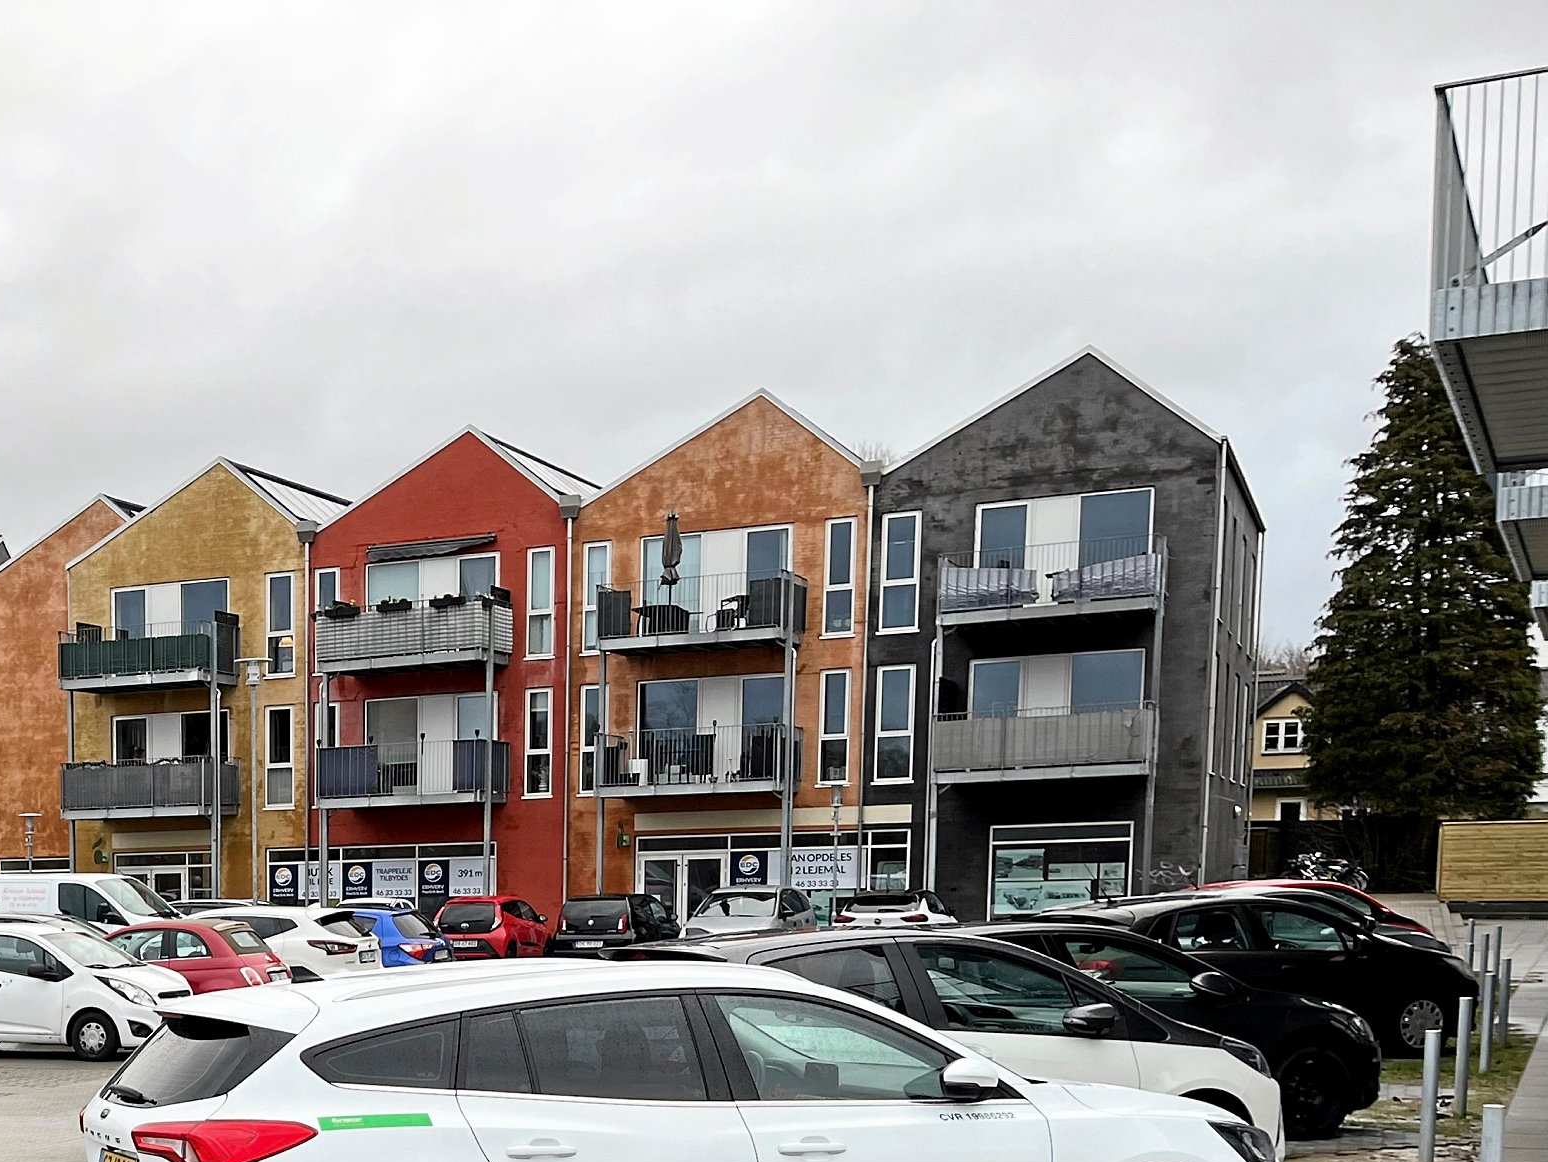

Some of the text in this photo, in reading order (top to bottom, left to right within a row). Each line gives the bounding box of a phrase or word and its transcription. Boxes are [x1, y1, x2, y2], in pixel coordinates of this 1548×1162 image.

[307, 868, 333, 876] BUK
[458, 869, 473, 877] 391
[795, 866, 801, 874] 2
[939, 1113, 963, 1121] CVR
